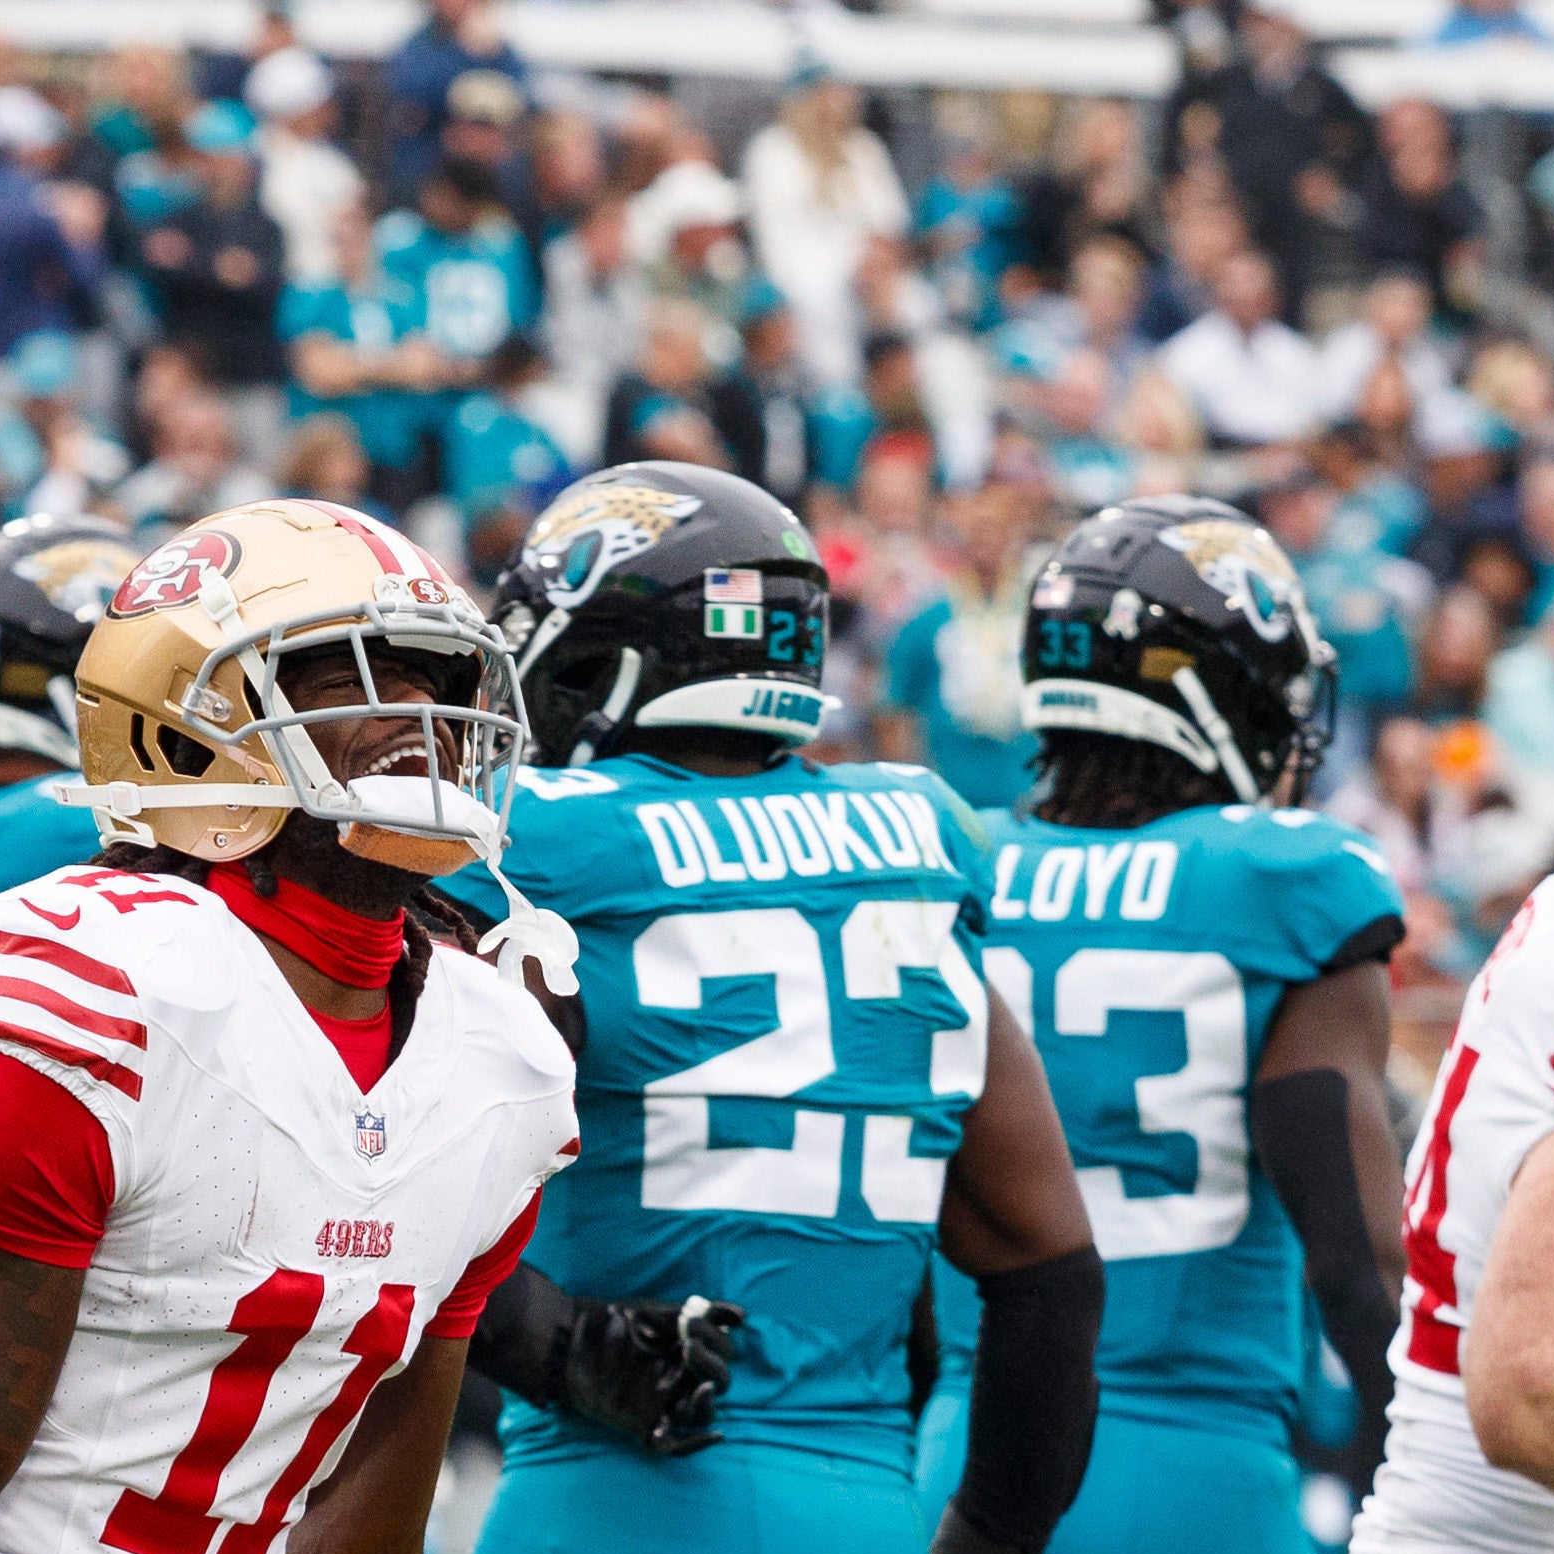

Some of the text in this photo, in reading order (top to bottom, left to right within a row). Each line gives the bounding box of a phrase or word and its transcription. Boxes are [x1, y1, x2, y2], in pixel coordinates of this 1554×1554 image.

[767, 610, 823, 667] 23
[1038, 620, 1093, 671] 33
[636, 790, 964, 889] OLUOKUN
[633, 900, 988, 1224] 23
[981, 945, 1251, 1262] 3
[358, 1130, 383, 1153] NFL
[315, 1219, 395, 1259] 49ERS
